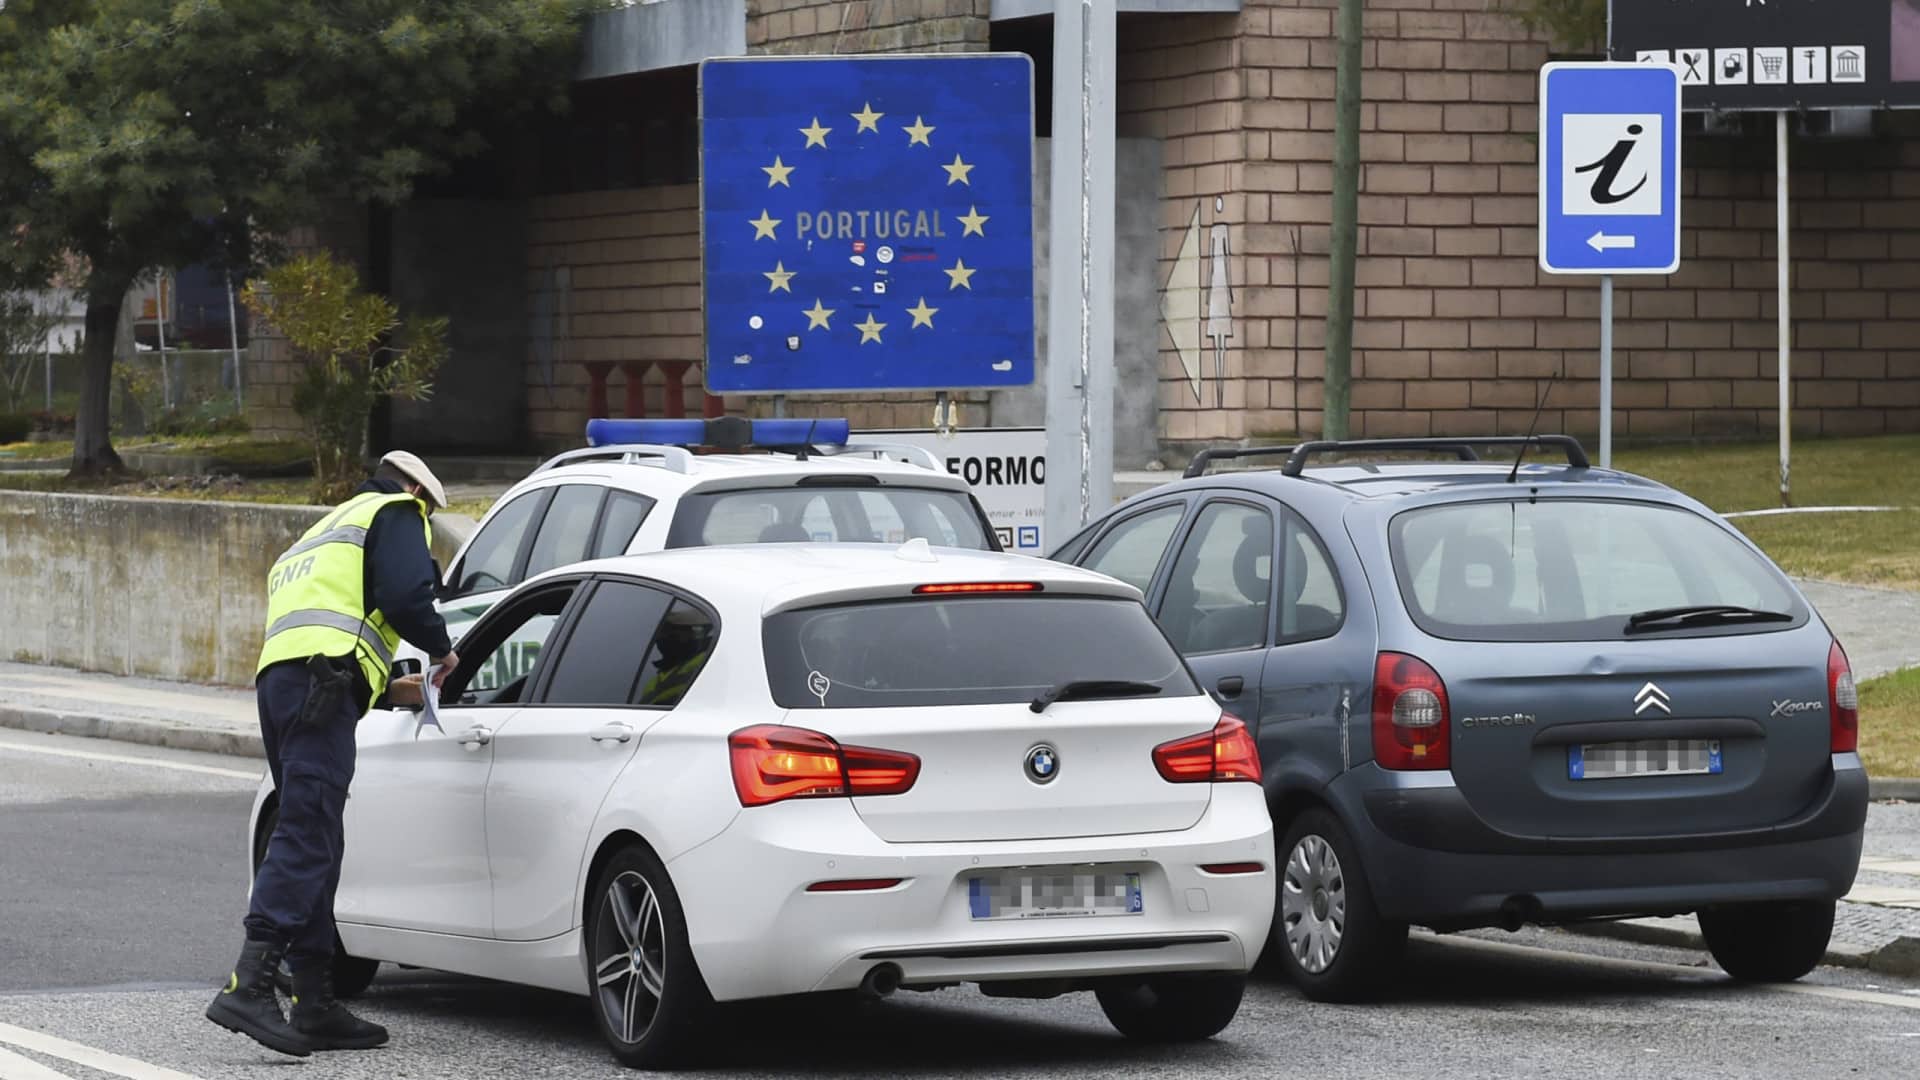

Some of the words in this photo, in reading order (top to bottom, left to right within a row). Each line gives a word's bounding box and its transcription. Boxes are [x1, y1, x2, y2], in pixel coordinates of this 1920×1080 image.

[797, 209, 946, 239] PORTUGAL
[946, 455, 1045, 486] FORMO
[987, 510, 1016, 518] enue
[271, 555, 315, 595] GNR
[1462, 713, 1536, 727] CITROËN
[1770, 699, 1823, 717] Xsara
